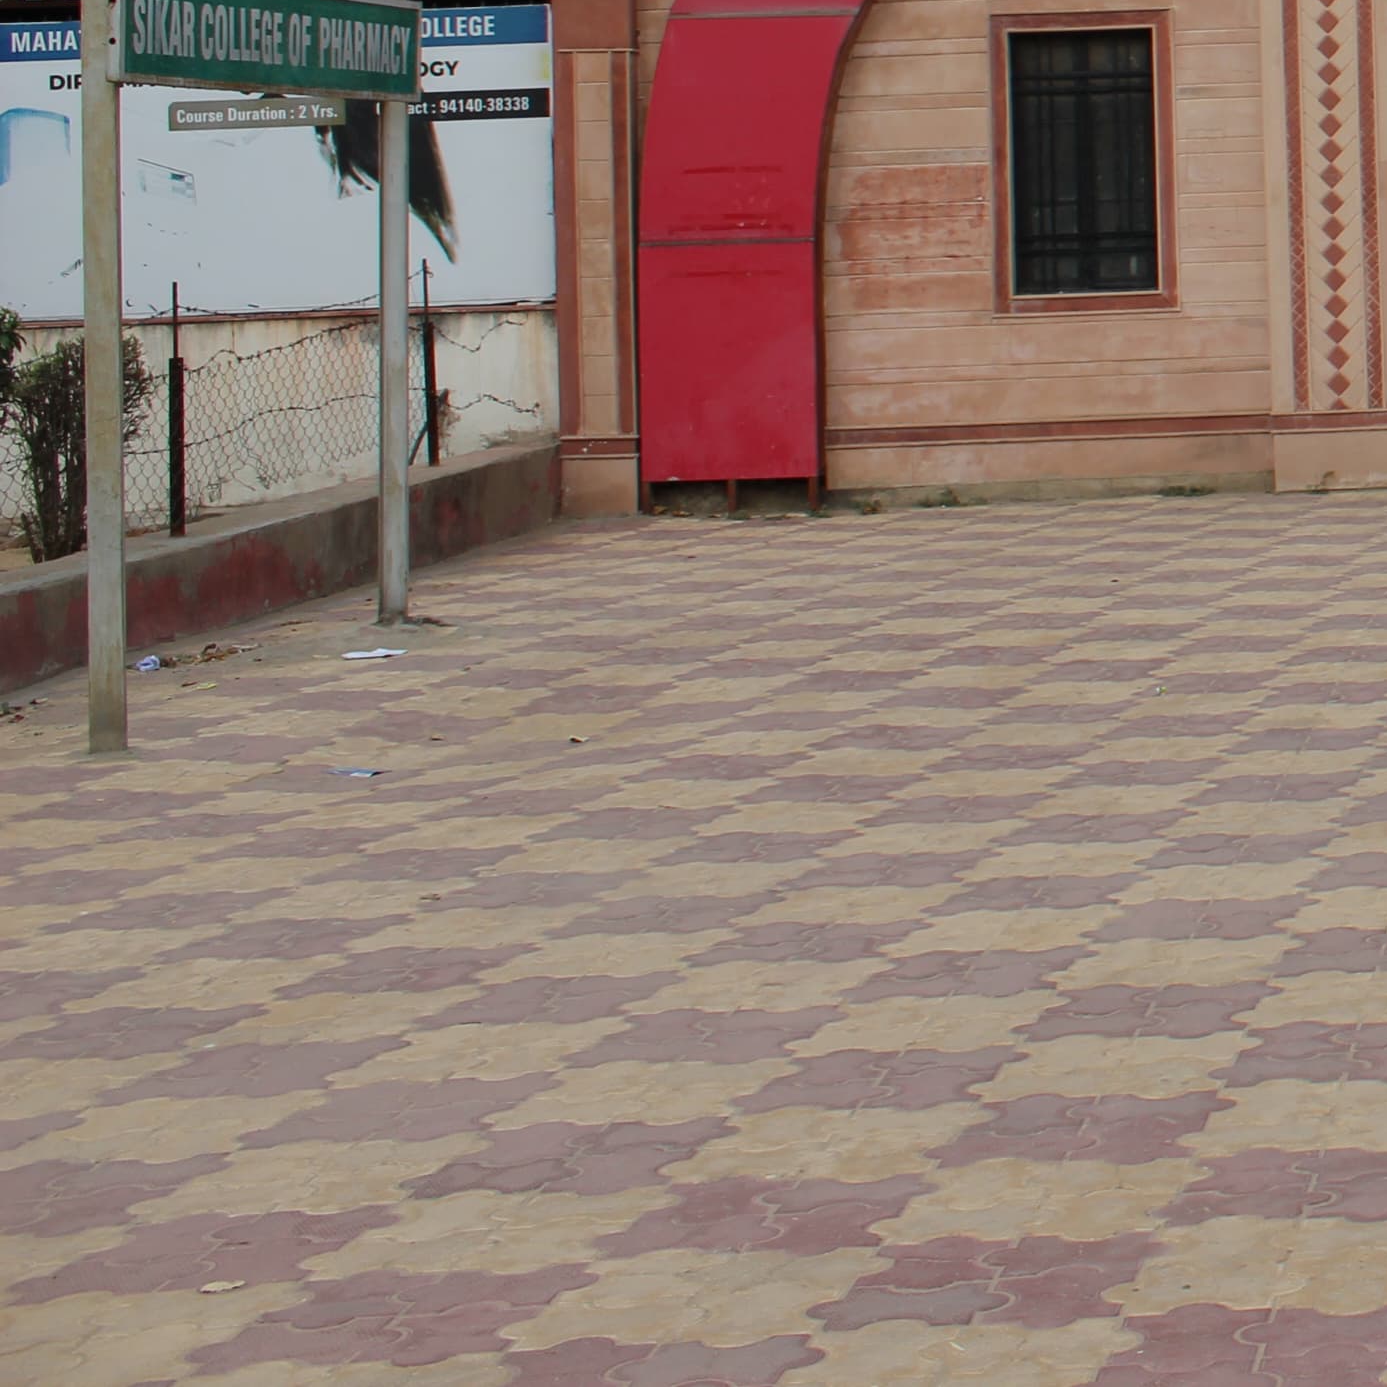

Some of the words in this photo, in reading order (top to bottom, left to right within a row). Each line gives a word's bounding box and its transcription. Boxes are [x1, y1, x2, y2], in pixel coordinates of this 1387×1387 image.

[11, 30, 81, 53] MAHA
[421, 15, 495, 38] OLLEGE
[201, 3, 284, 64] COLLEGE
[288, 12, 312, 67] OF
[318, 17, 411, 74] PHARMACY
[176, 108, 223, 124] Course
[227, 105, 287, 122] Duration
[298, 104, 306, 119] 2
[311, 103, 338, 119] Yrs.
[440, 96, 529, 114] 94140-38338
